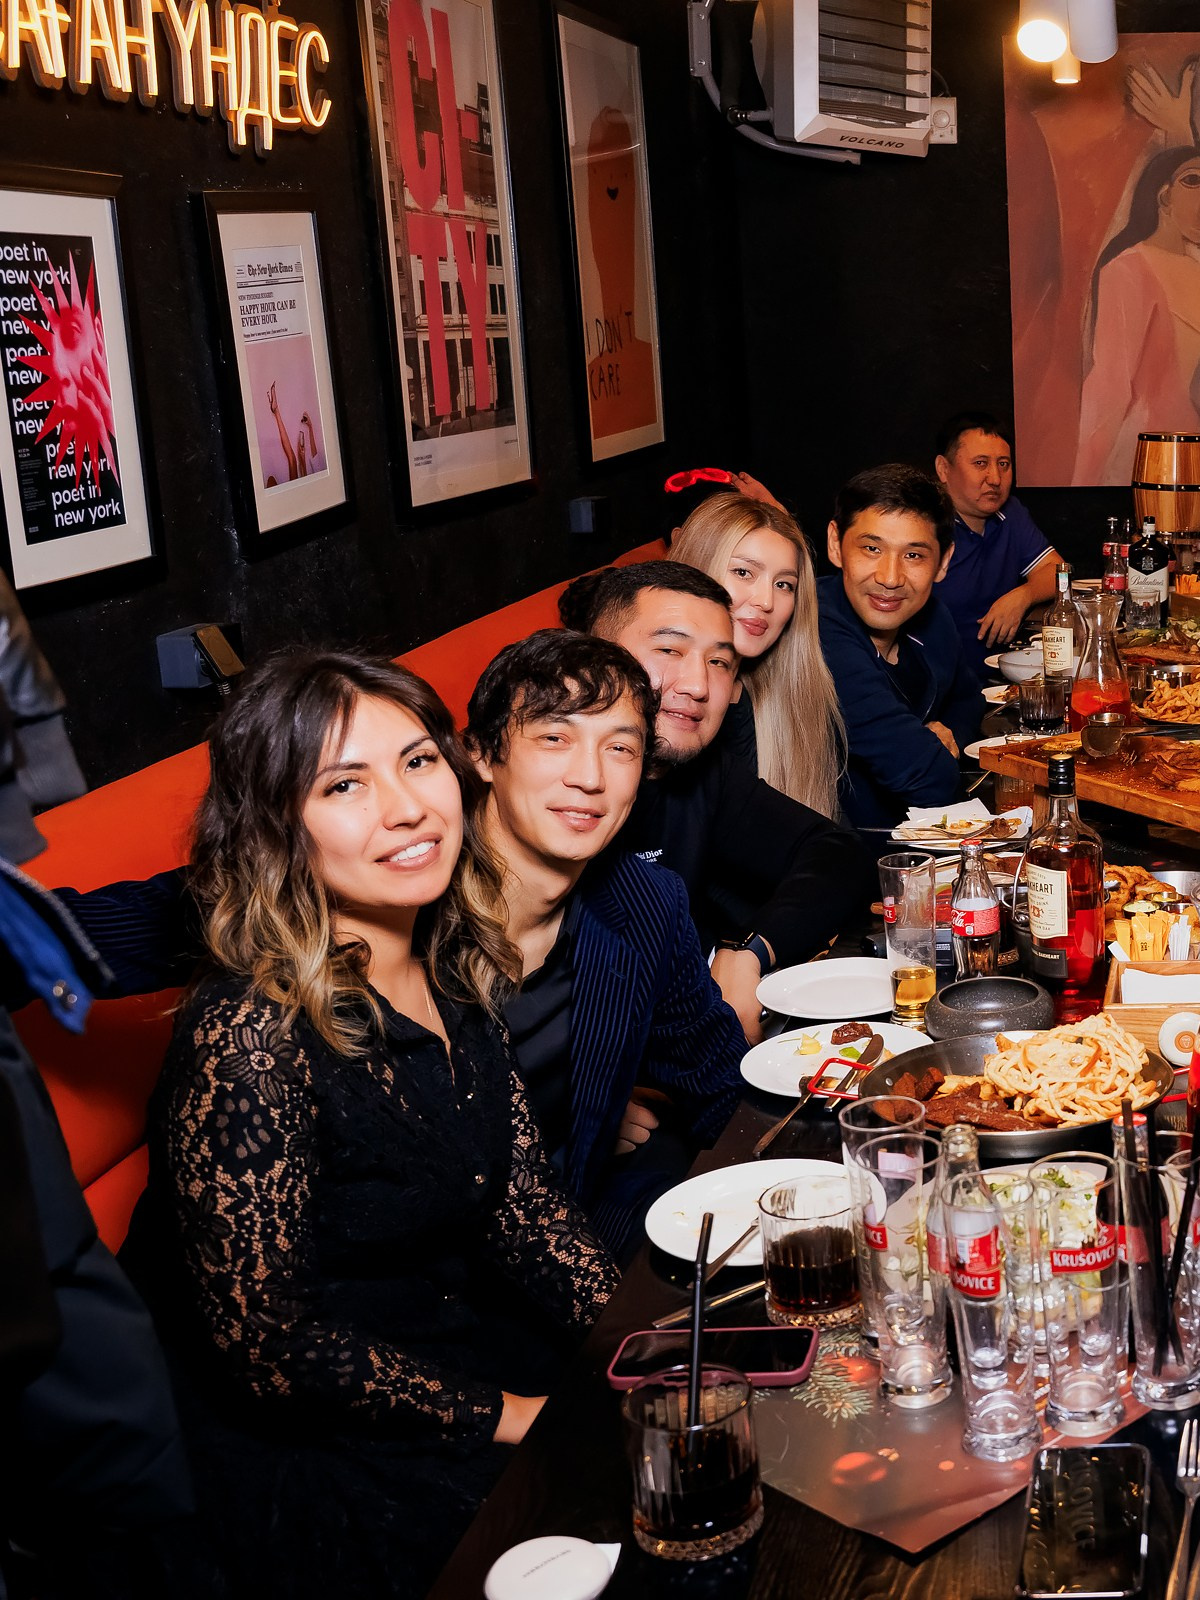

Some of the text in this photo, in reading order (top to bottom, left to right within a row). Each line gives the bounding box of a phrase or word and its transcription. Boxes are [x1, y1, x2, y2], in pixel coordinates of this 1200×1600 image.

[840, 135, 904, 149] VOLCANO
[32, 241, 48, 262] in
[34, 266, 71, 289] york
[256, 263, 267, 276] New
[267, 262, 280, 278] York
[279, 262, 294, 274] Times
[0, 295, 38, 316] poet
[240, 299, 297, 315] HAPPY HOUR CAN BE
[241, 313, 278, 327] EVERY HOUR
[585, 321, 591, 356] I
[9, 368, 43, 385] new
[590, 363, 621, 401] CARE
[52, 484, 86, 510] poet
[55, 498, 121, 527] new york
[644, 849, 664, 859] Dior
